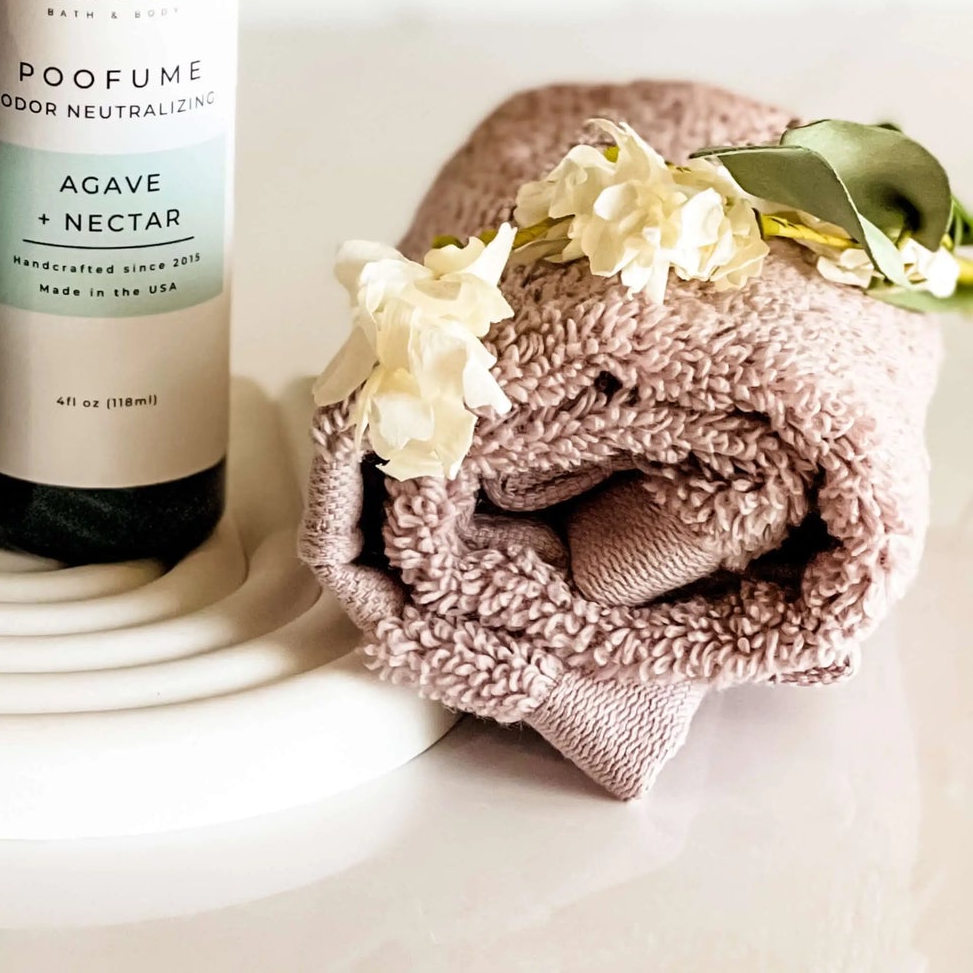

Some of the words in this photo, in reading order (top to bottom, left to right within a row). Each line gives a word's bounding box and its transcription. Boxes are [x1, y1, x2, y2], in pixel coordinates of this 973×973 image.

[47, 8, 94, 19] BATH
[111, 11, 118, 19] &
[135, 7, 179, 19] BODY
[19, 60, 202, 89] POOFUME
[1, 93, 57, 116] ODOR
[67, 91, 215, 119] NEUTRALIZING
[59, 173, 161, 195] AGAVE
[38, 213, 50, 225] +
[65, 208, 180, 233] NECTAR
[13, 255, 114, 274] Handcrafted
[123, 261, 165, 274] since
[173, 253, 201, 268] 2015
[39, 284, 80, 297] Made
[90, 287, 104, 297] in
[114, 286, 140, 297] the
[149, 282, 177, 295] USA
[56, 396, 76, 407] 4fl
[83, 398, 99, 408] oz
[107, 395, 157, 410] (118ml)
